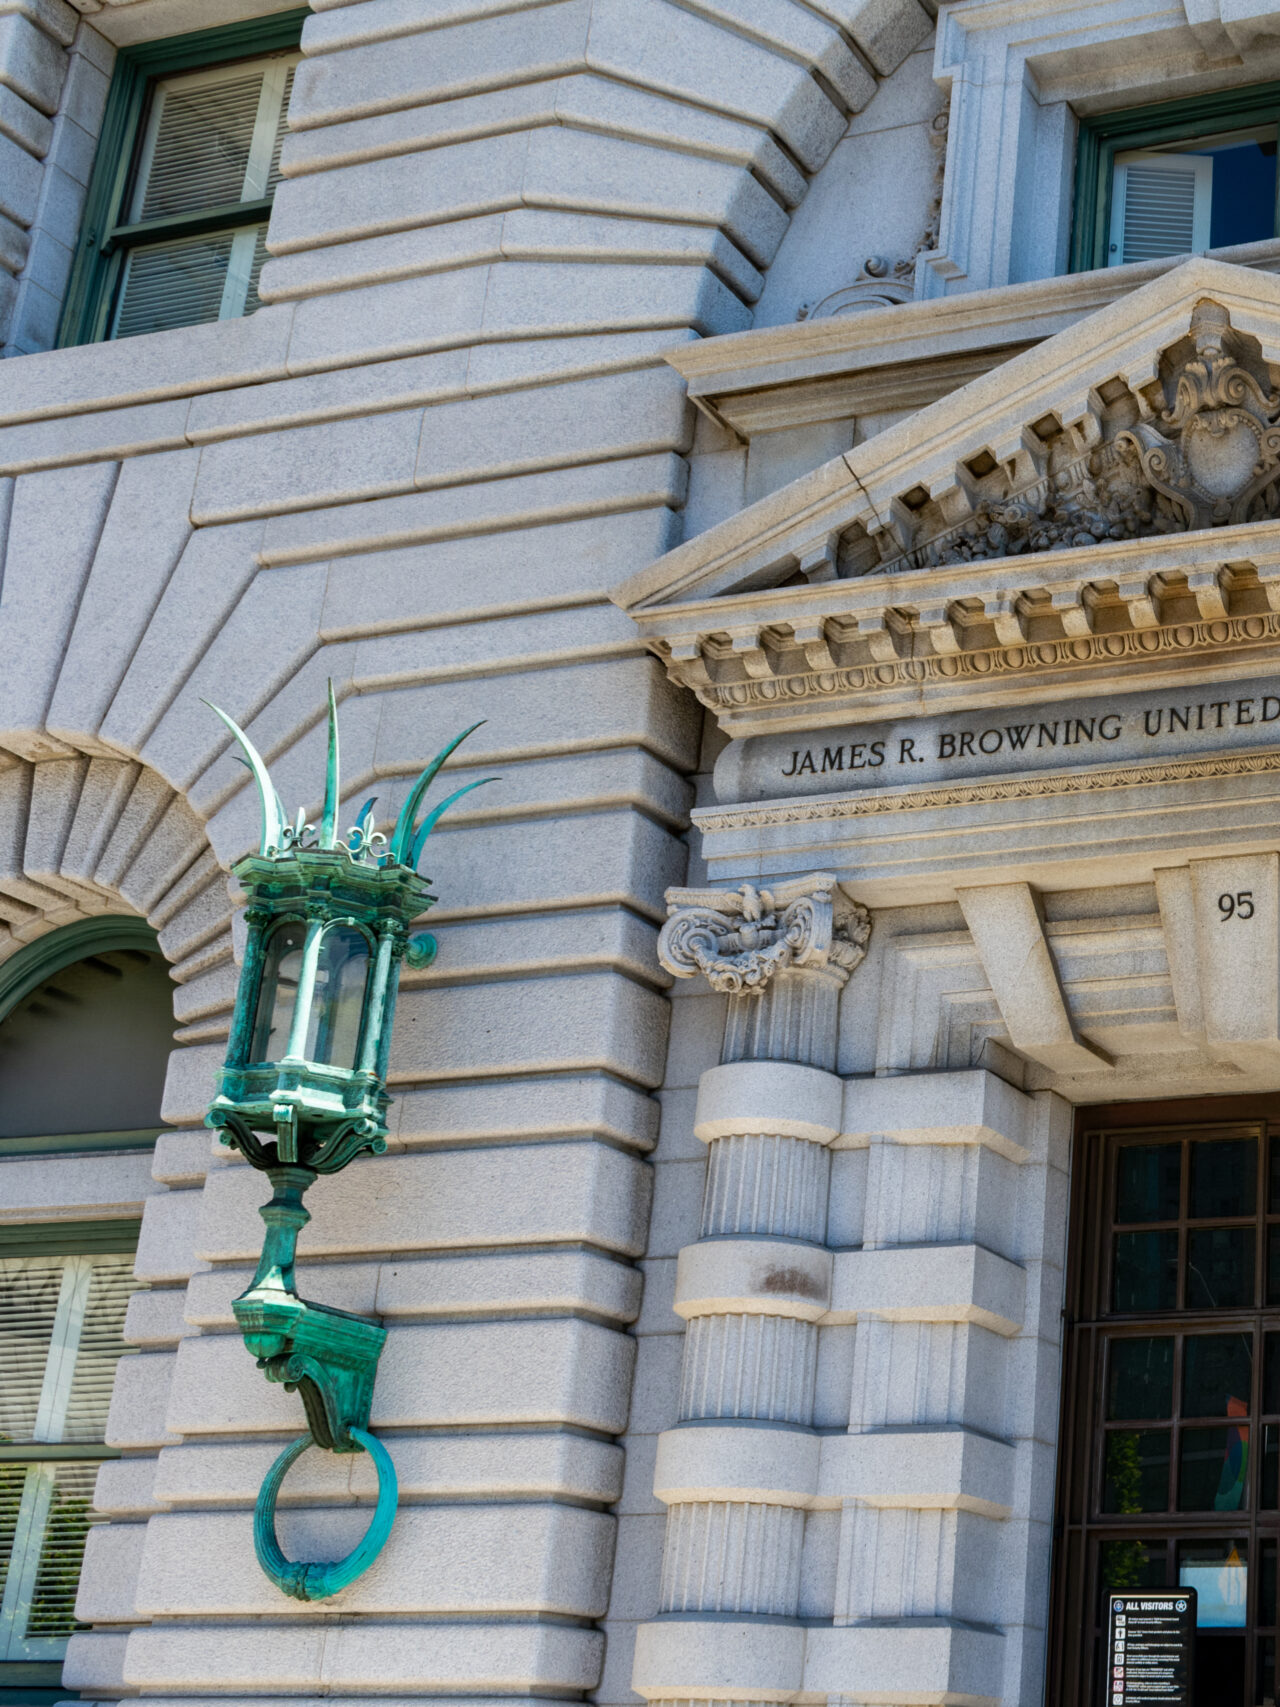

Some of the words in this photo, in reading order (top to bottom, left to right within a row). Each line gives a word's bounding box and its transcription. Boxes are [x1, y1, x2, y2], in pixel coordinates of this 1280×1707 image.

[781, 741, 887, 777] JAMES
[898, 738, 925, 764] R.
[936, 714, 1123, 760] BROWNING
[1217, 890, 1255, 922] 95
[1125, 1601, 1140, 1611] ALL
[1140, 1601, 1174, 1611] VISITORS
